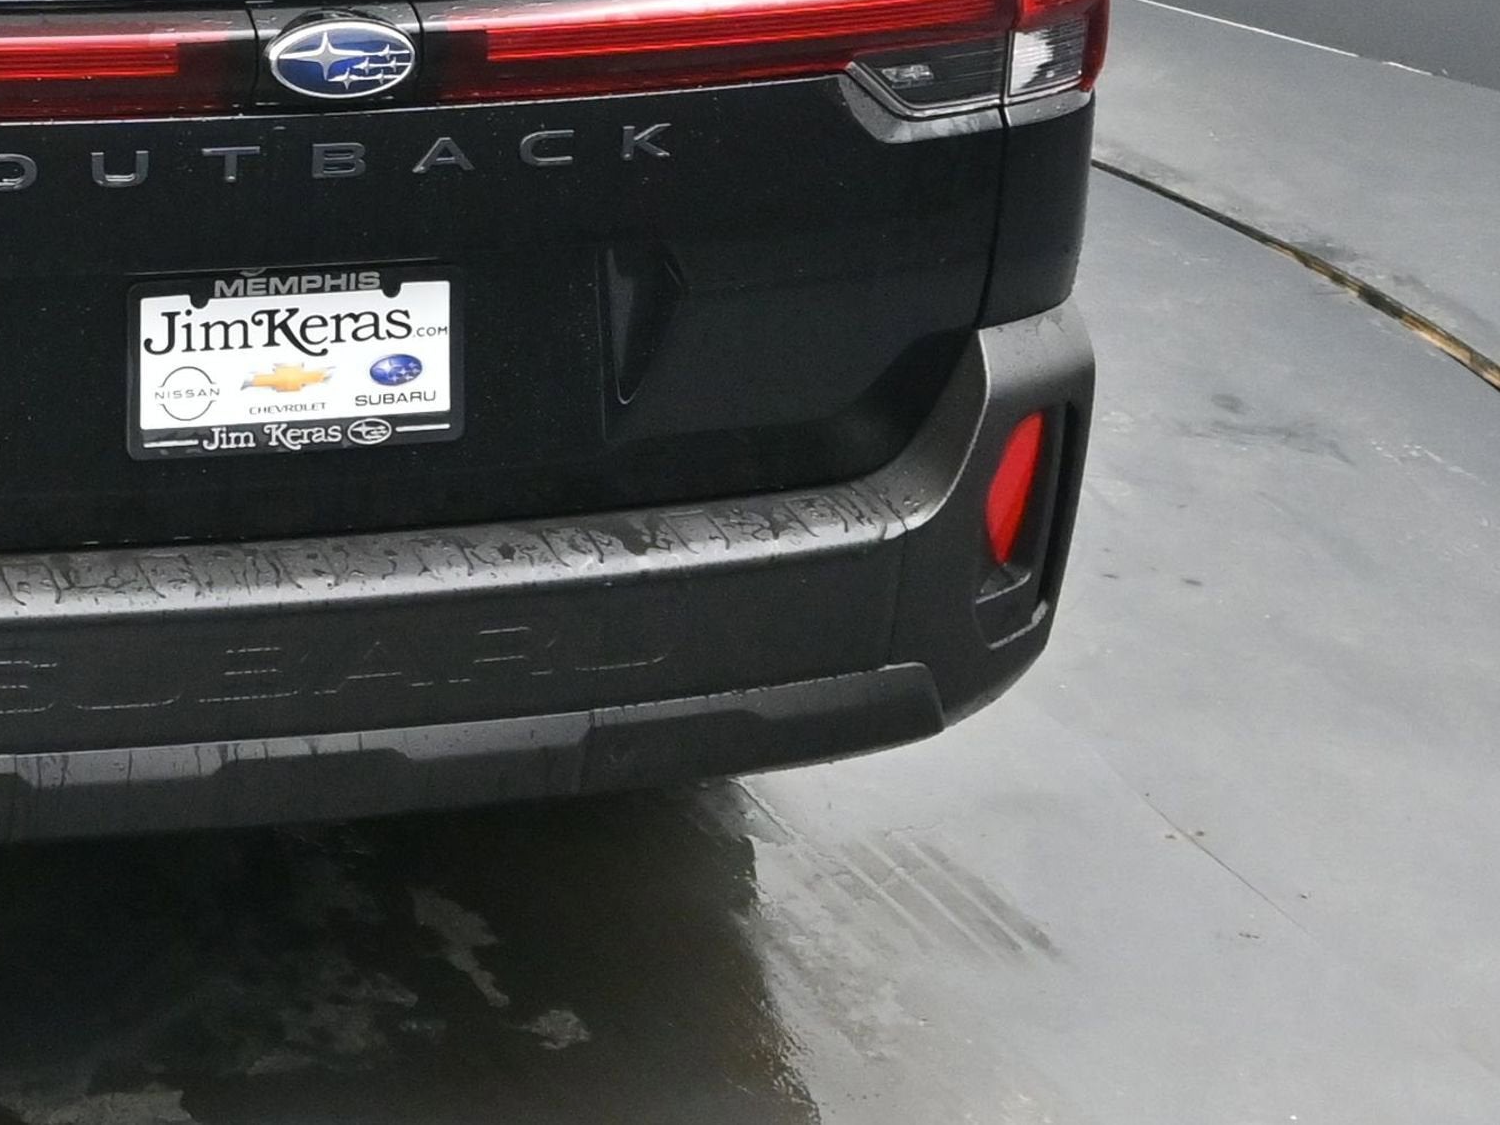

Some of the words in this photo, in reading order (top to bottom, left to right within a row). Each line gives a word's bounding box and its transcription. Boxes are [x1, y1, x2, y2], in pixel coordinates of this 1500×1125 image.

[213, 270, 381, 298] MEMPHIS
[154, 386, 221, 401] NISSAN
[354, 389, 437, 407] SUBARU
[248, 400, 328, 416] CHEVROLET
[202, 426, 256, 451] Jim
[263, 422, 342, 450] Keras
